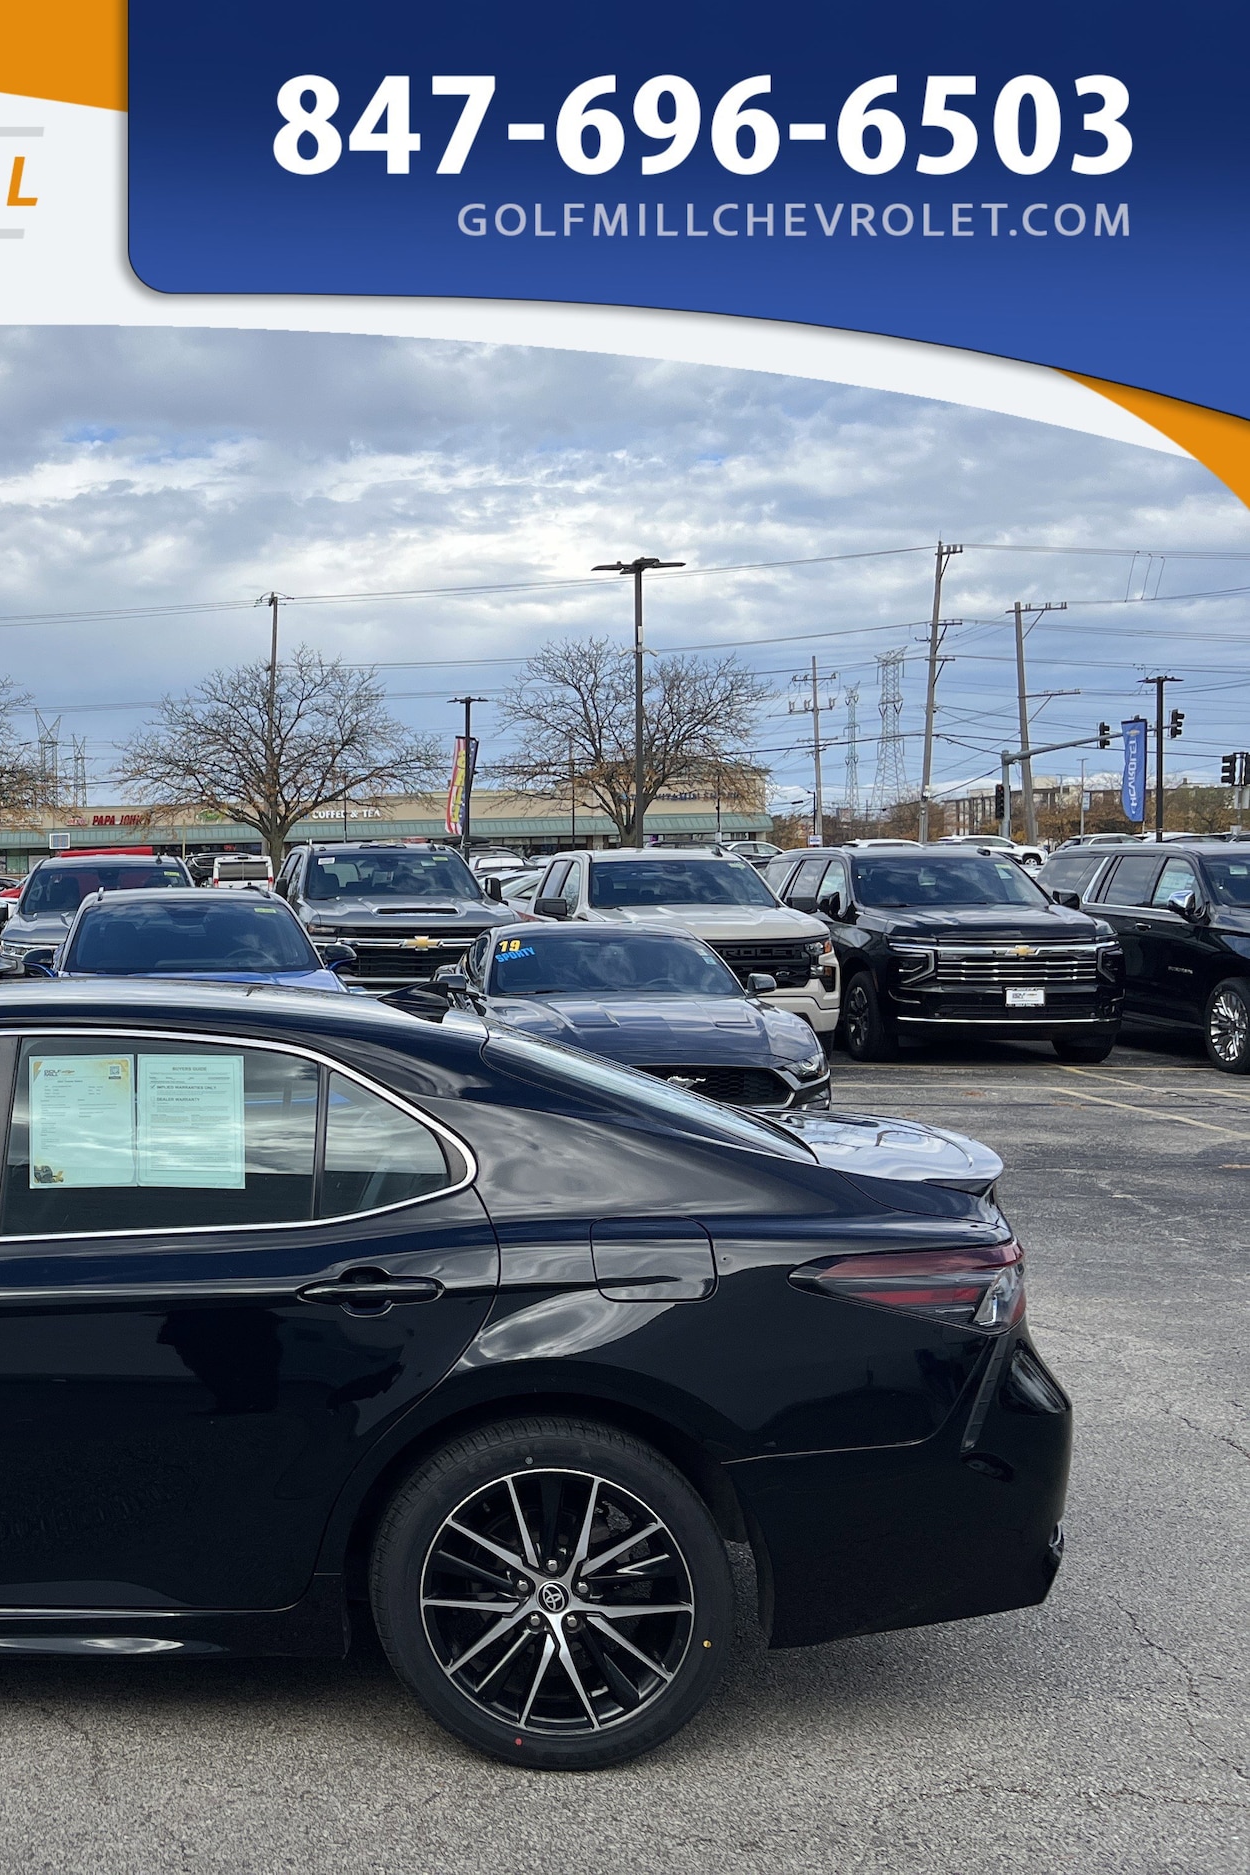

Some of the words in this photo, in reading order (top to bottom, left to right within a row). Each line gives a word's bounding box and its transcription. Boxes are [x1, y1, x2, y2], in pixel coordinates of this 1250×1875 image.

[362, 808, 382, 818] TEA
[92, 815, 116, 826] PAPA
[499, 940, 521, 952] 19
[495, 946, 536, 963] SPORTY
